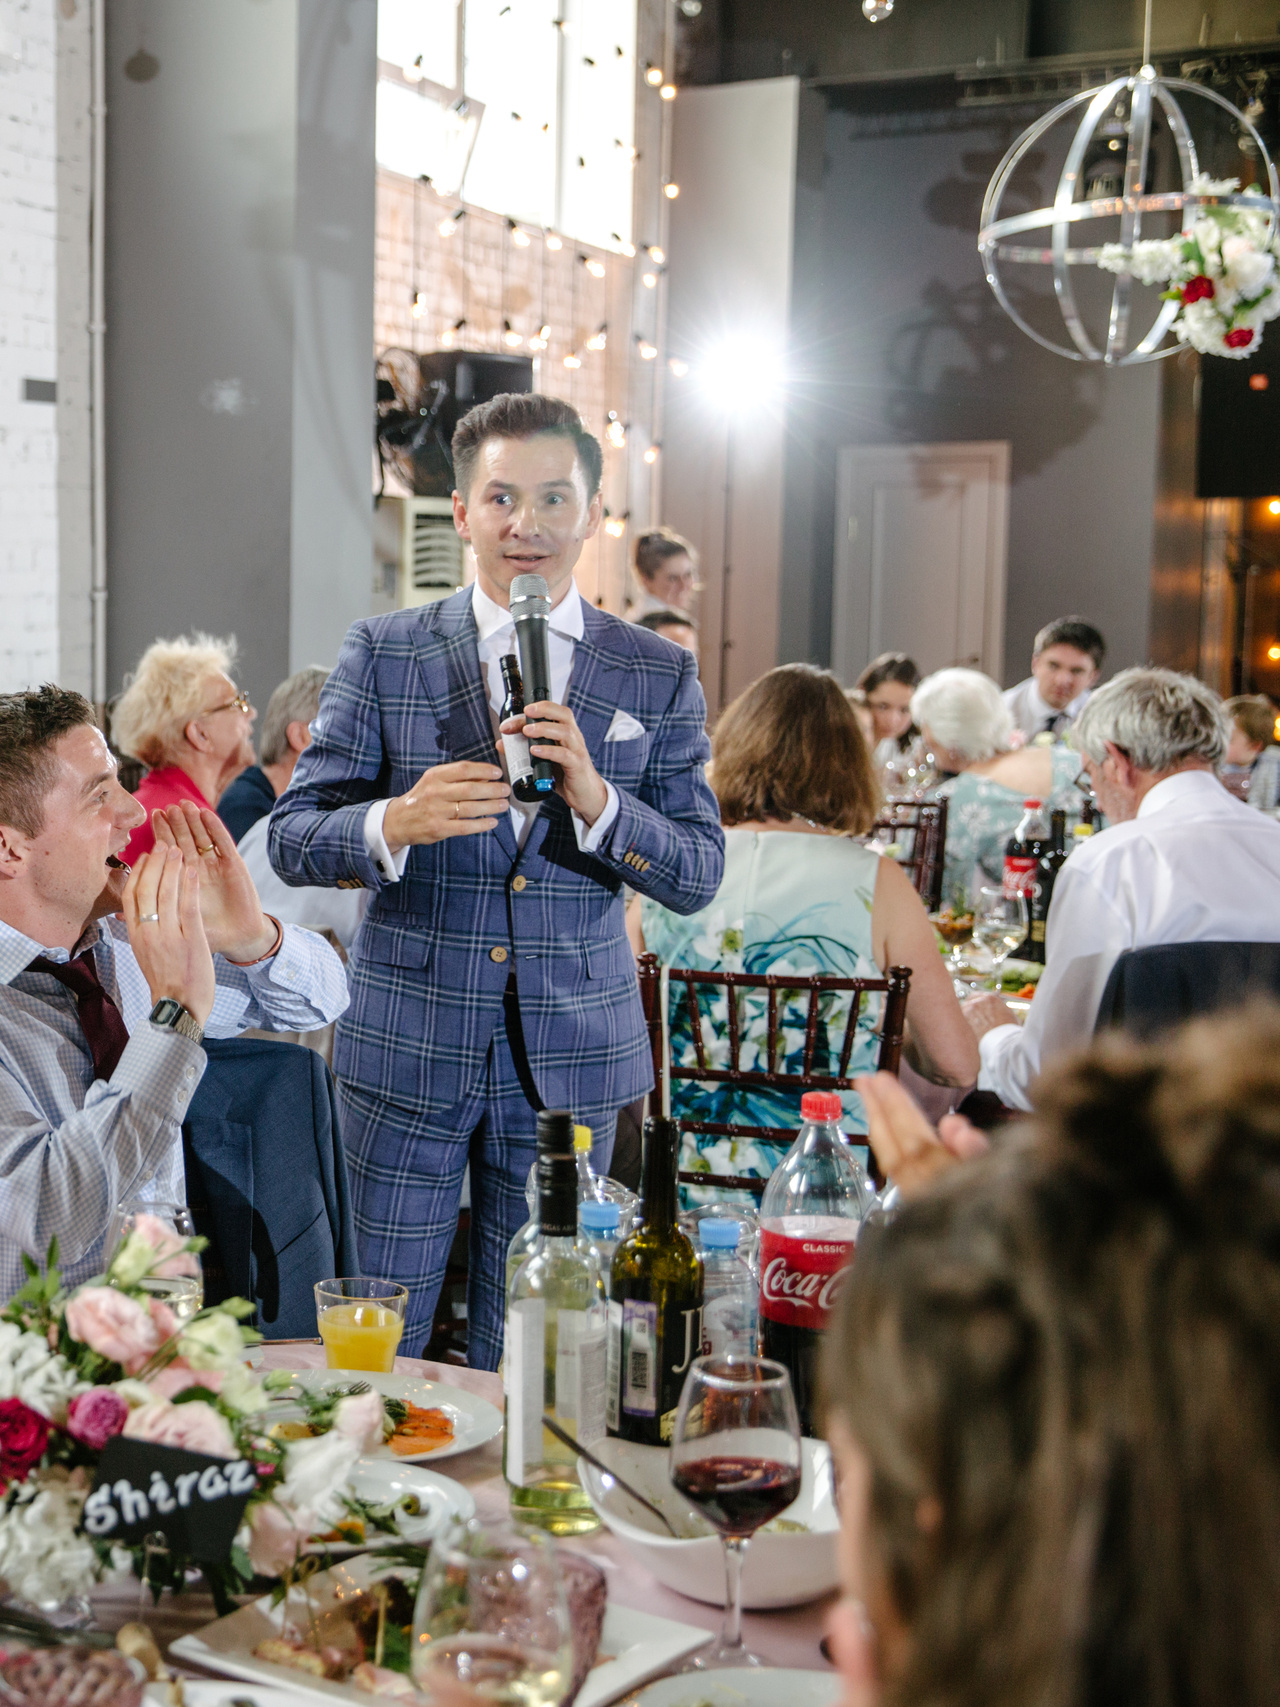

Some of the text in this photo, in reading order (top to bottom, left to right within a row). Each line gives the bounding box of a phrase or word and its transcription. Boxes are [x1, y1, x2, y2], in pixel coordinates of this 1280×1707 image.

[802, 1243, 847, 1254] CLASSIC
[762, 1257, 854, 1309] Coca-C
[84, 1459, 258, 1536] Shiraz
